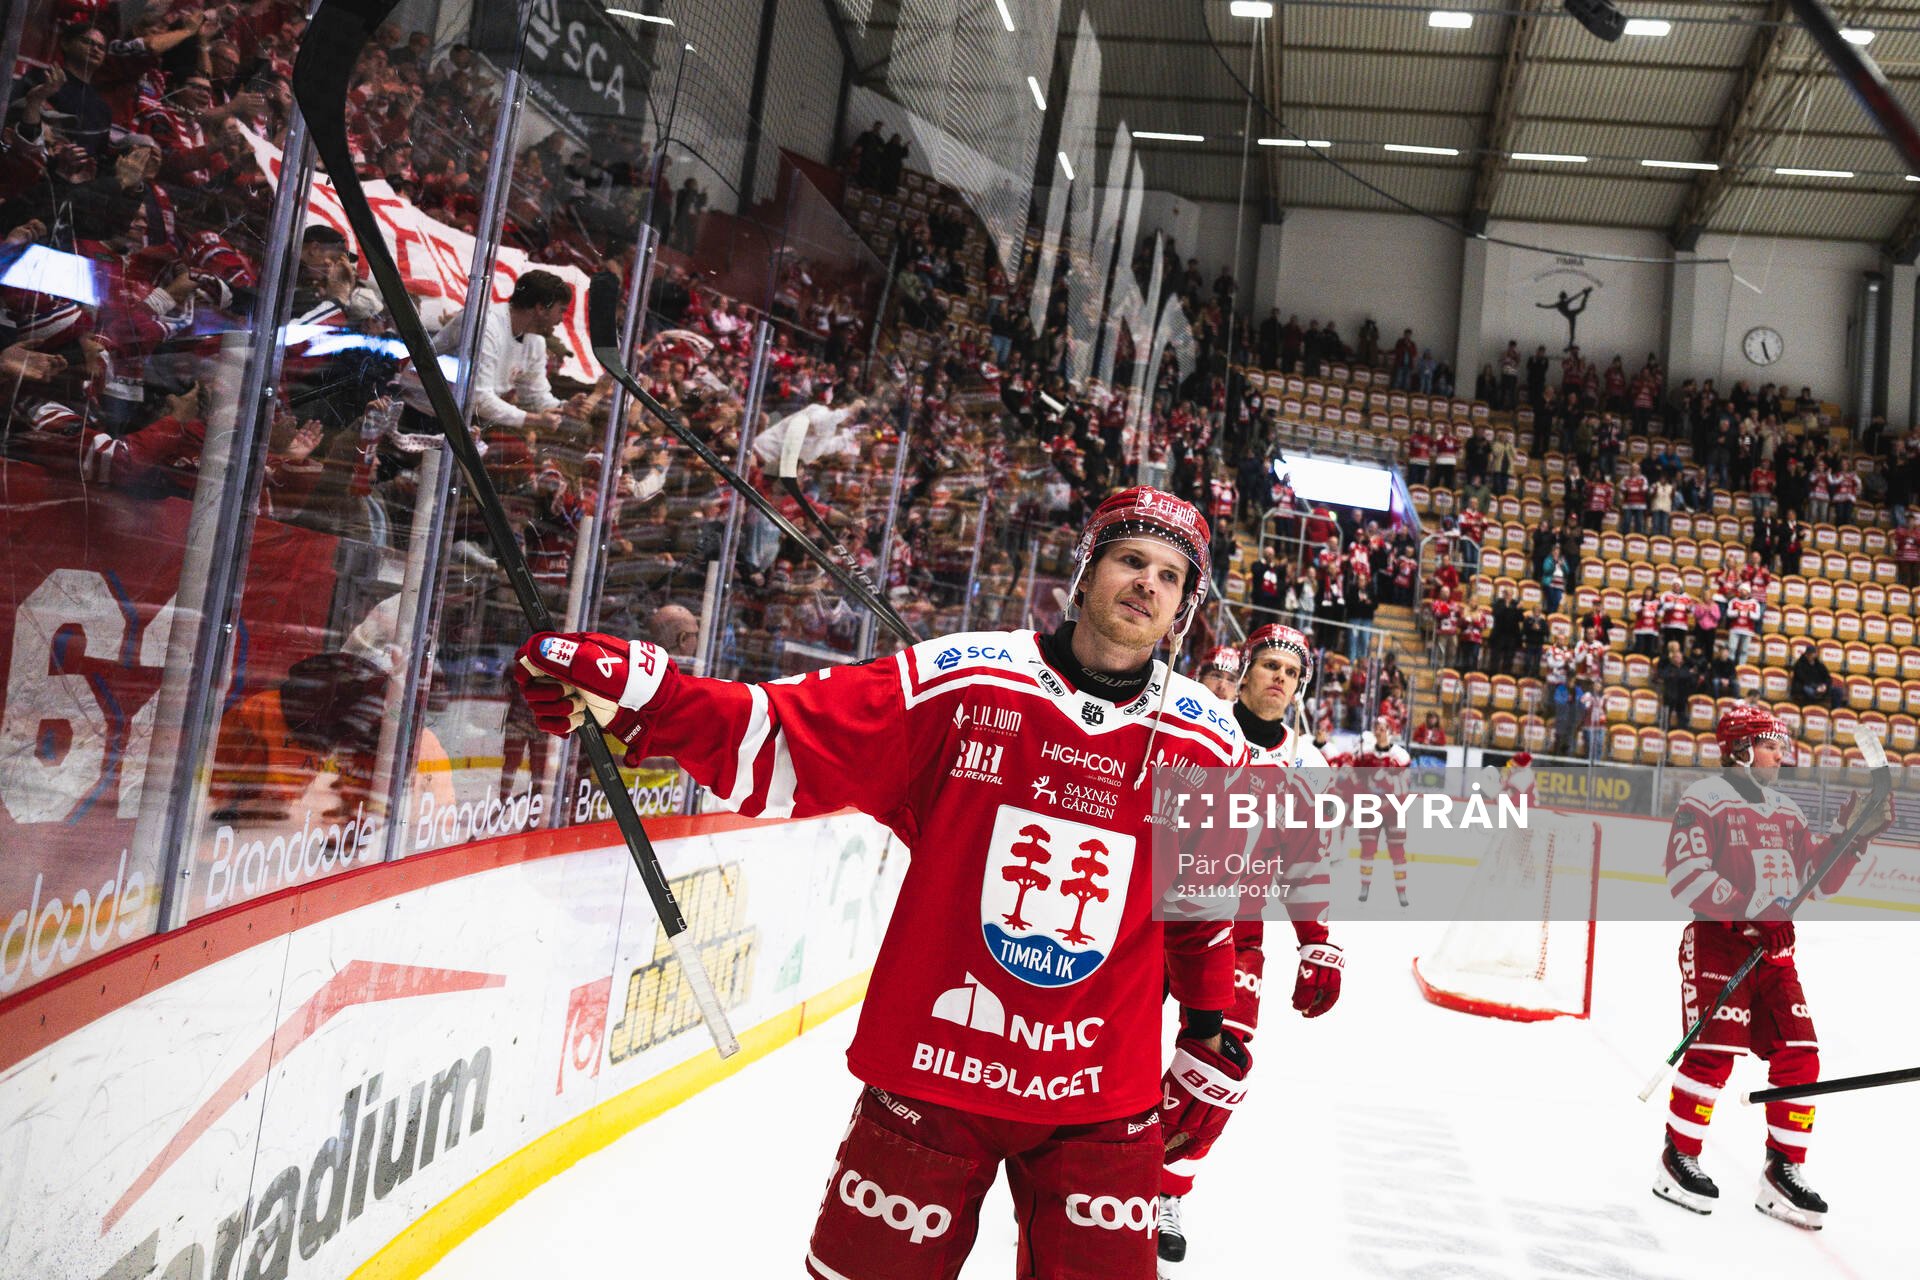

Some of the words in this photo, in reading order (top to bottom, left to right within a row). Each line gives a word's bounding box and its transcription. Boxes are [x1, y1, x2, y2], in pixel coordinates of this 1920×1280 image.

[562, 20, 626, 116] SCA
[967, 646, 1013, 663] SCA
[1041, 671, 1063, 695] EAB
[972, 705, 1022, 732] LILIUM
[1081, 707, 1105, 726] 50
[963, 770, 1003, 786] RENTAL
[1041, 741, 1126, 779] HIGHCON
[575, 774, 683, 823] Bradcode
[1061, 797, 1115, 820] GÅRDEN
[1064, 782, 1118, 807] SAXNÄS
[416, 780, 542, 850] Brandcode
[206, 800, 376, 909] Brandcode
[1673, 826, 1708, 862] 26
[1000, 938, 1054, 974] TIMRÅ
[1055, 953, 1078, 980] IK
[1009, 1014, 1105, 1052] NHC
[1711, 1005, 1751, 1027] oop
[911, 1042, 1104, 1101] BILBOLAGET
[839, 1169, 953, 1244] coop
[1065, 1193, 1161, 1240] coop
